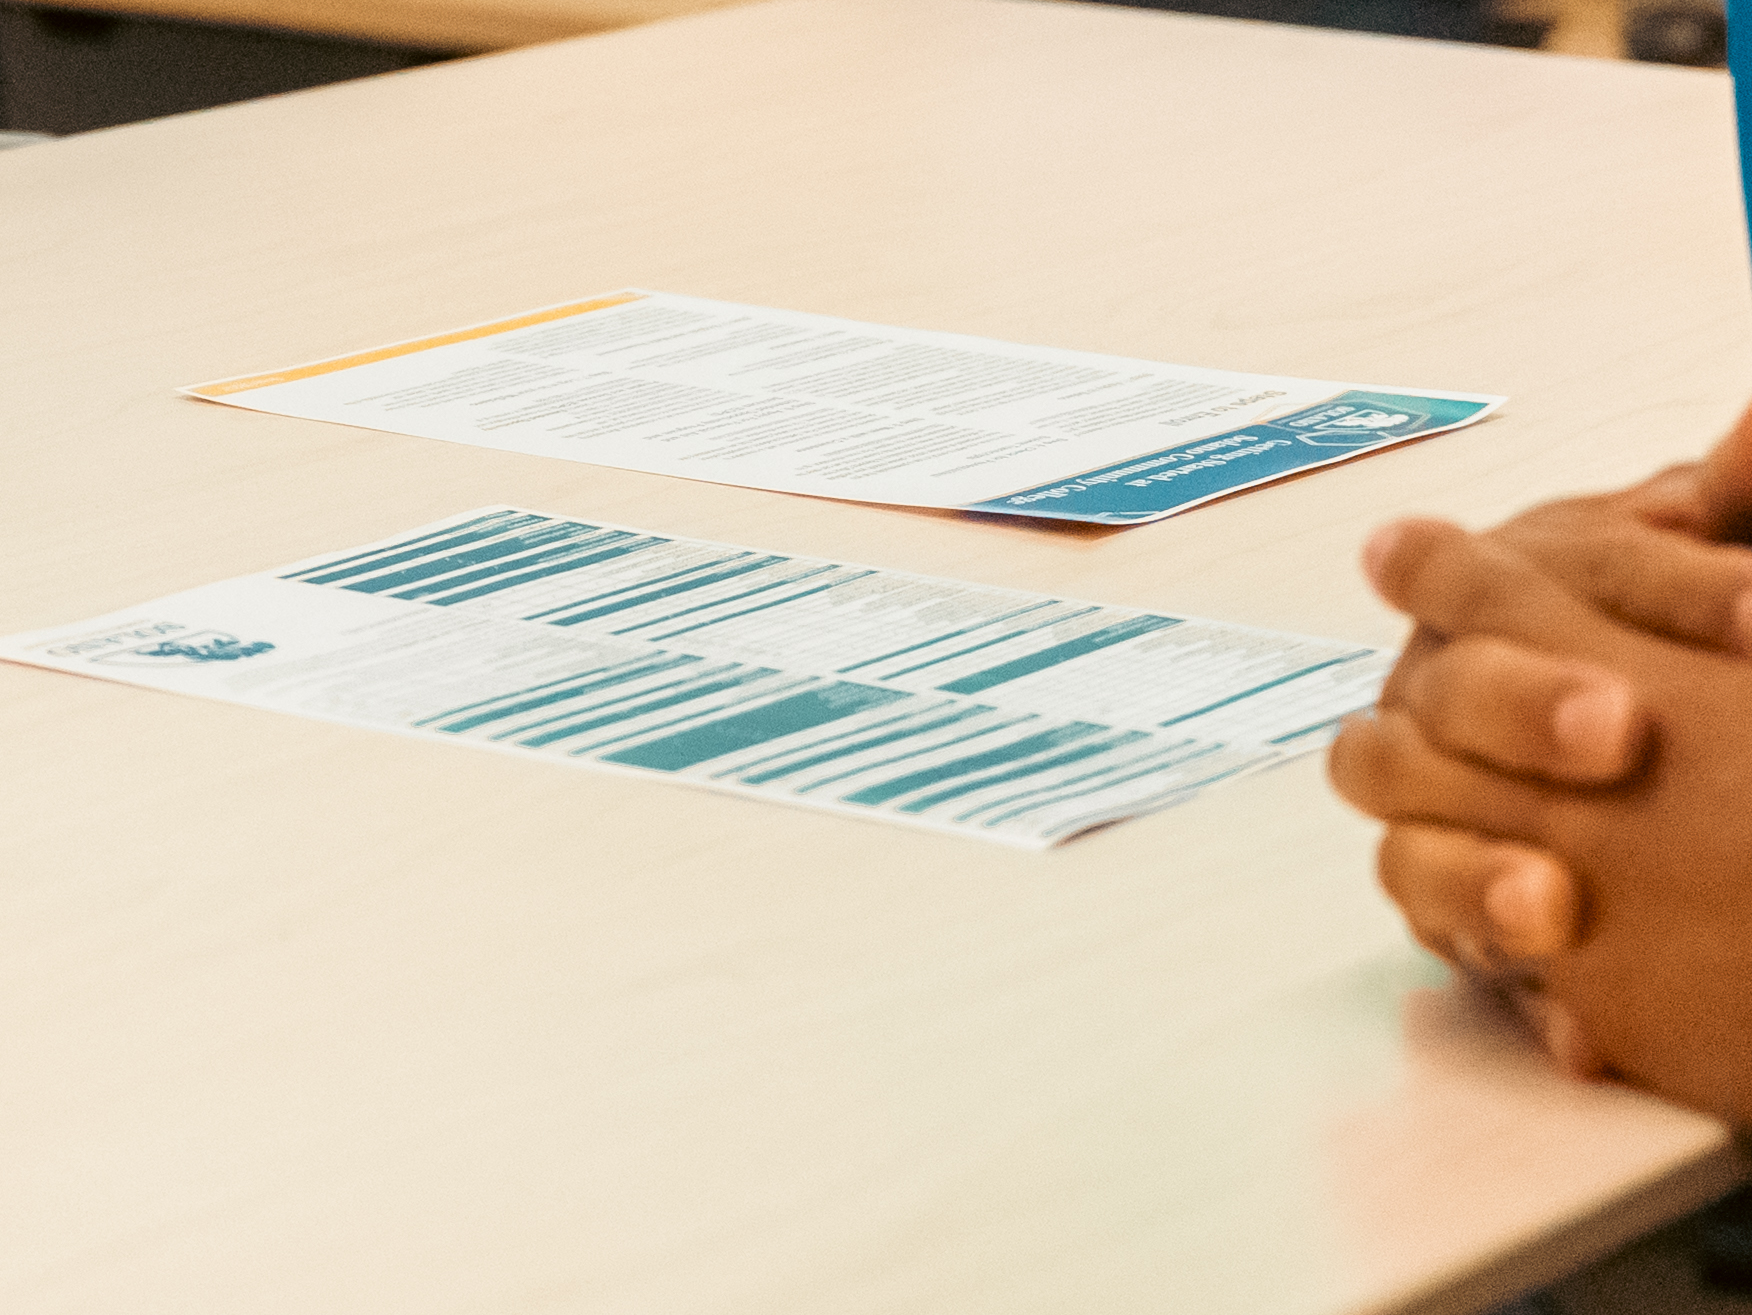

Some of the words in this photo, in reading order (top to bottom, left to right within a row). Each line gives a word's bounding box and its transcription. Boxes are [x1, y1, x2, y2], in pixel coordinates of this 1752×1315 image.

[1230, 390, 1287, 407] Steps
[1159, 411, 1221, 427] Enroll
[1185, 434, 1259, 455] Solano
[1209, 439, 1292, 461] Getting
[1075, 453, 1195, 486] Community
[1146, 458, 1227, 482] Started
[1125, 478, 1152, 487] at
[1006, 484, 1087, 505] College
